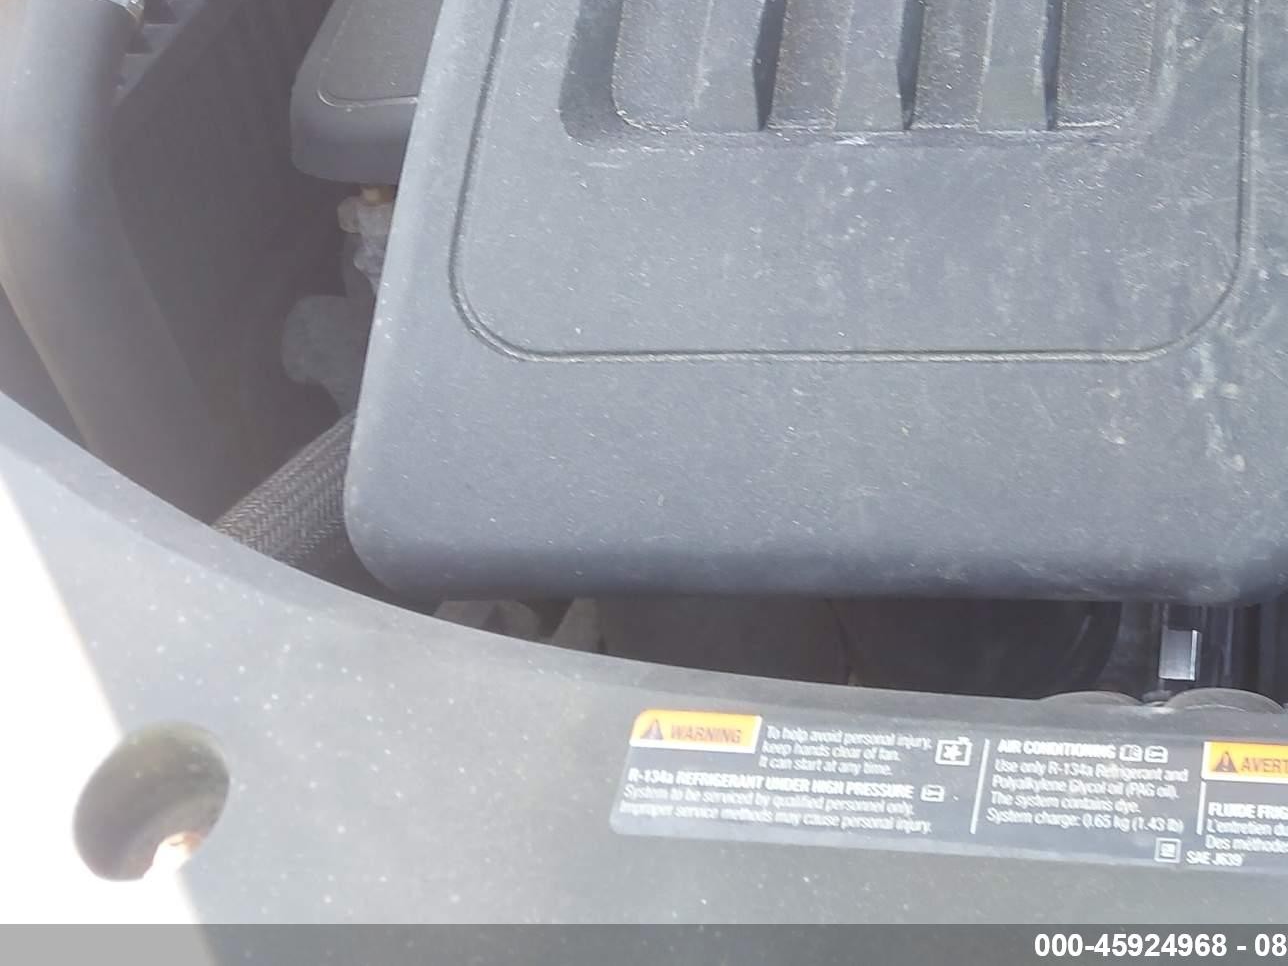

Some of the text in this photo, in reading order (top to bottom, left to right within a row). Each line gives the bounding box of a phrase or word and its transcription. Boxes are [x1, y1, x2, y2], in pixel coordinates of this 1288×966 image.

[671, 725, 742, 744] WARNING
[767, 726, 780, 739] To
[782, 727, 808, 743] help
[810, 729, 842, 743] avoid
[843, 732, 895, 746] personal
[761, 741, 792, 756] keep
[793, 743, 831, 757] hands
[832, 746, 861, 759] clear
[863, 747, 878, 760] of
[998, 739, 1116, 759] AIR CONDITIONING
[769, 757, 792, 770] can
[794, 759, 822, 771] start
[822, 760, 837, 772] at
[838, 762, 861, 776] any
[995, 759, 1188, 782] Use only R-134a Refrigerant and
[628, 768, 915, 799] R-134a REFRIGERANT UNDER HIGH PRESSURE
[992, 774, 1067, 793] Polyalkylene
[1068, 780, 1107, 795] Glycol
[1107, 782, 1123, 795] oil
[1125, 782, 1155, 798] (PAG
[623, 784, 668, 800] System
[670, 788, 683, 801] to
[685, 788, 701, 802] be
[703, 791, 753, 806] serviced
[755, 792, 770, 807] by
[772, 795, 824, 810] qualified
[825, 799, 885, 813] personnel
[991, 791, 1013, 806] The
[1014, 794, 1059, 809] system
[1061, 797, 1113, 811] contains
[674, 806, 719, 819] service
[720, 808, 773, 823] methods
[774, 811, 800, 826] may
[802, 814, 840, 827] cause
[840, 816, 894, 830] personal
[1208, 801, 1256, 818] FLUIDE
[986, 807, 1032, 824] System
[1113, 816, 1130, 832] kg
[1166, 818, 1185, 834] lb)
[1207, 819, 1272, 836] L'entretien
[1205, 835, 1231, 850] Des
[1186, 850, 1211, 865] SAE
